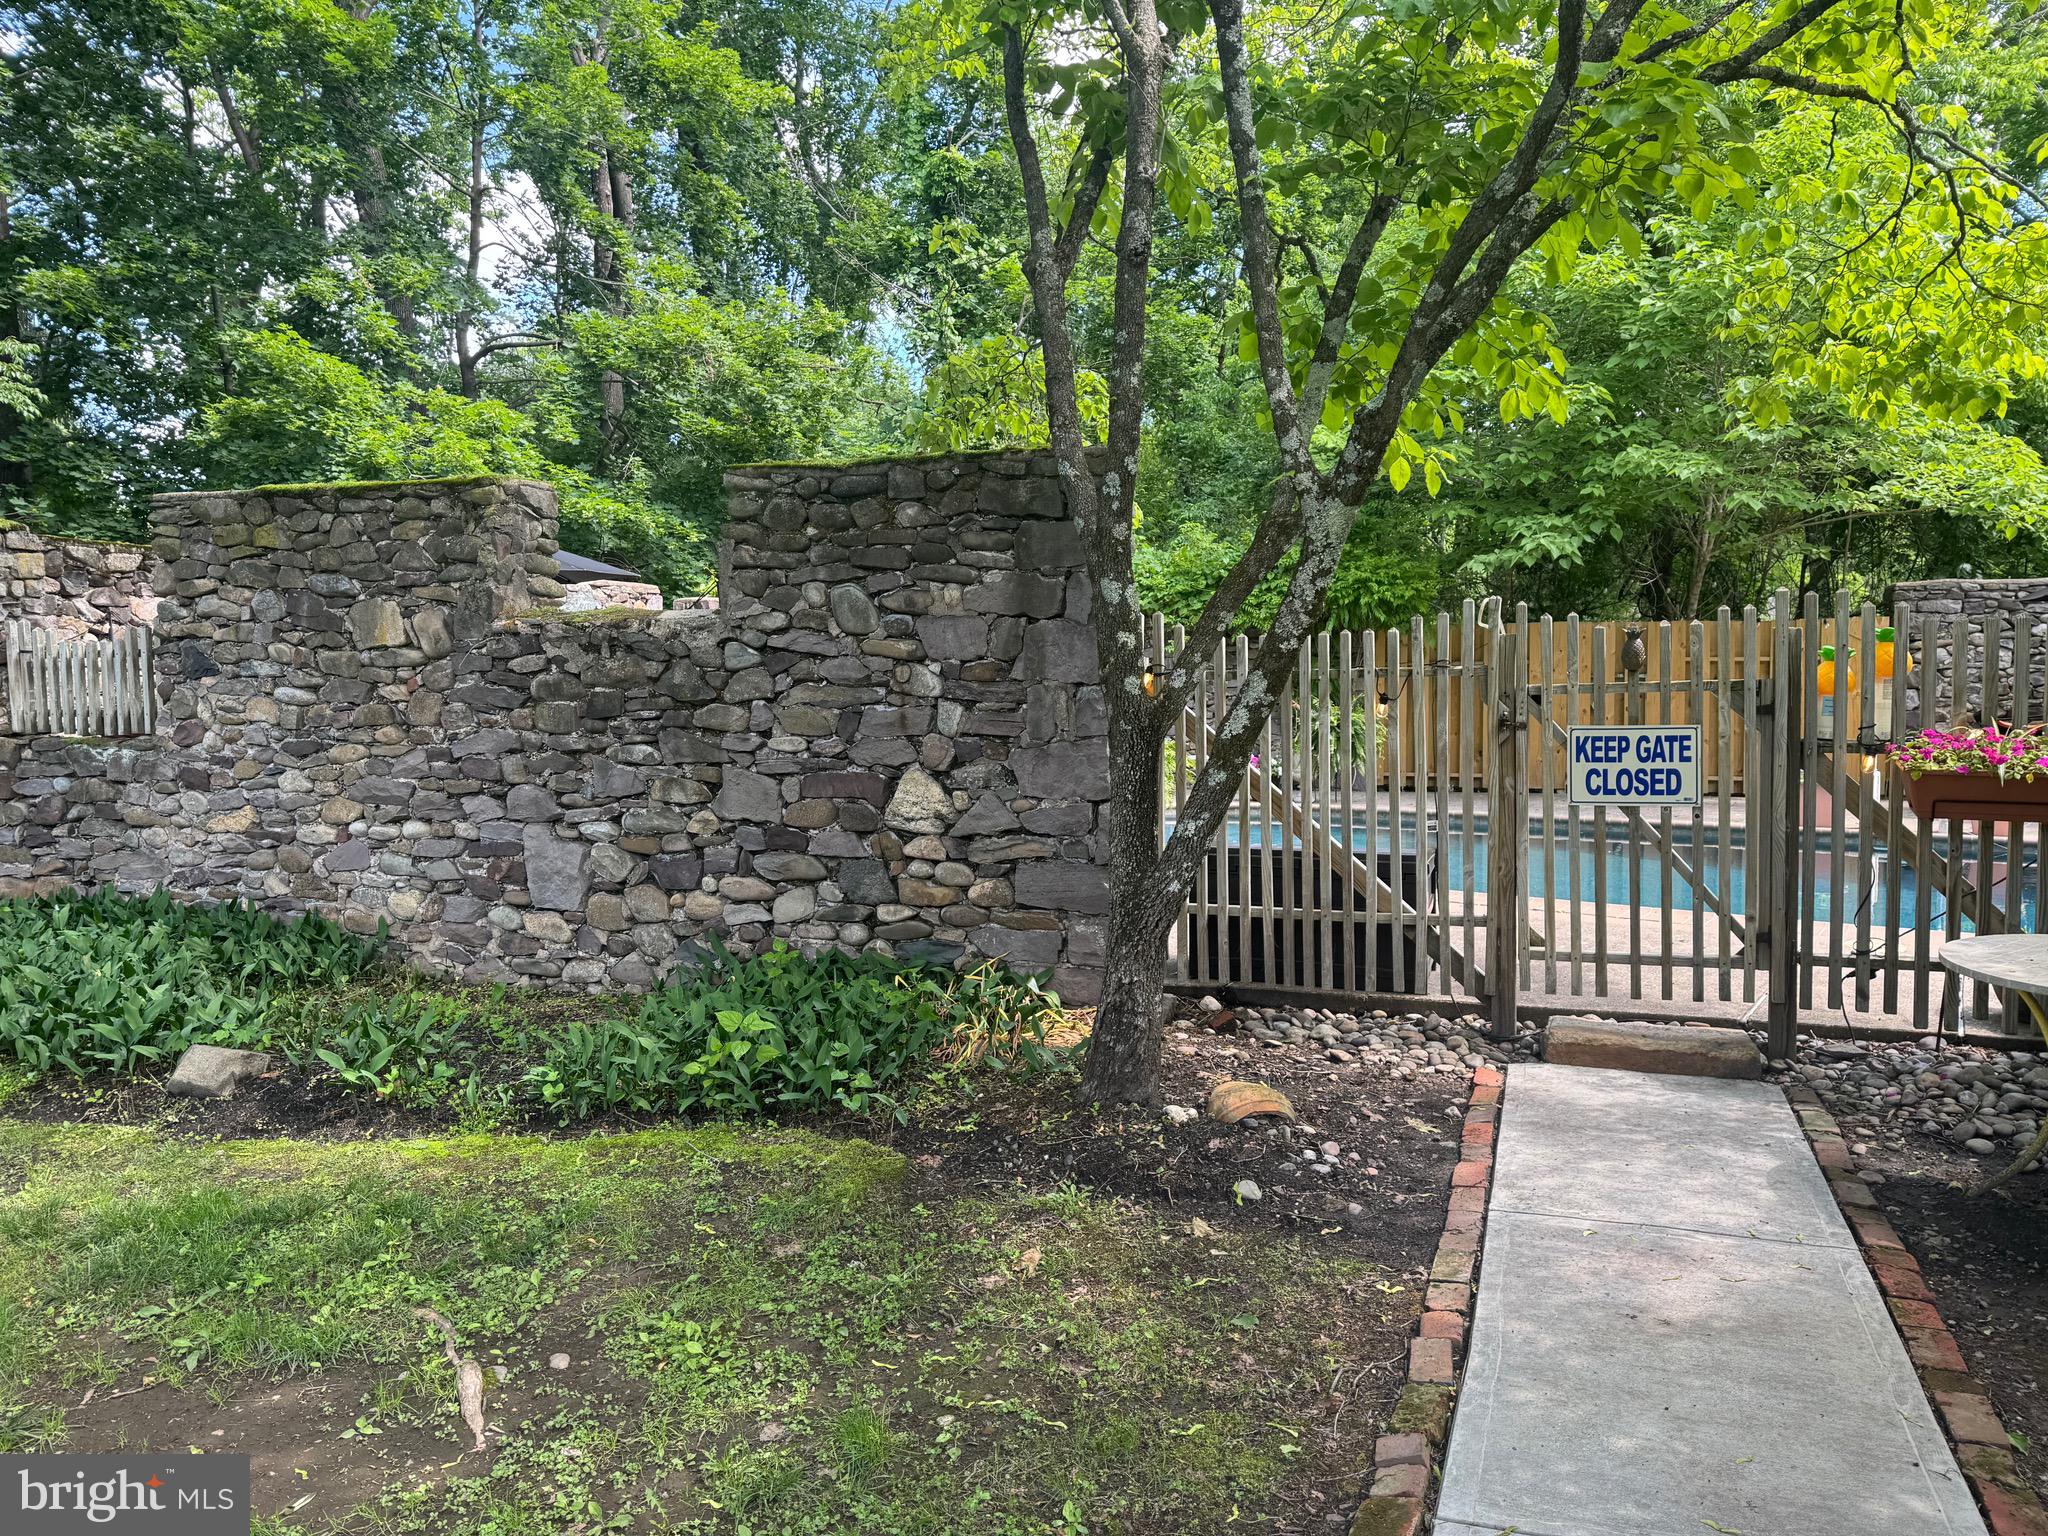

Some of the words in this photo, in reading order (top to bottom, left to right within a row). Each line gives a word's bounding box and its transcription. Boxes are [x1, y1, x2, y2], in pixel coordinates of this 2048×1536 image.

[1576, 736, 1630, 763] KEEP
[1636, 735, 1692, 763] GATE
[1585, 768, 1682, 796] CLOSED
